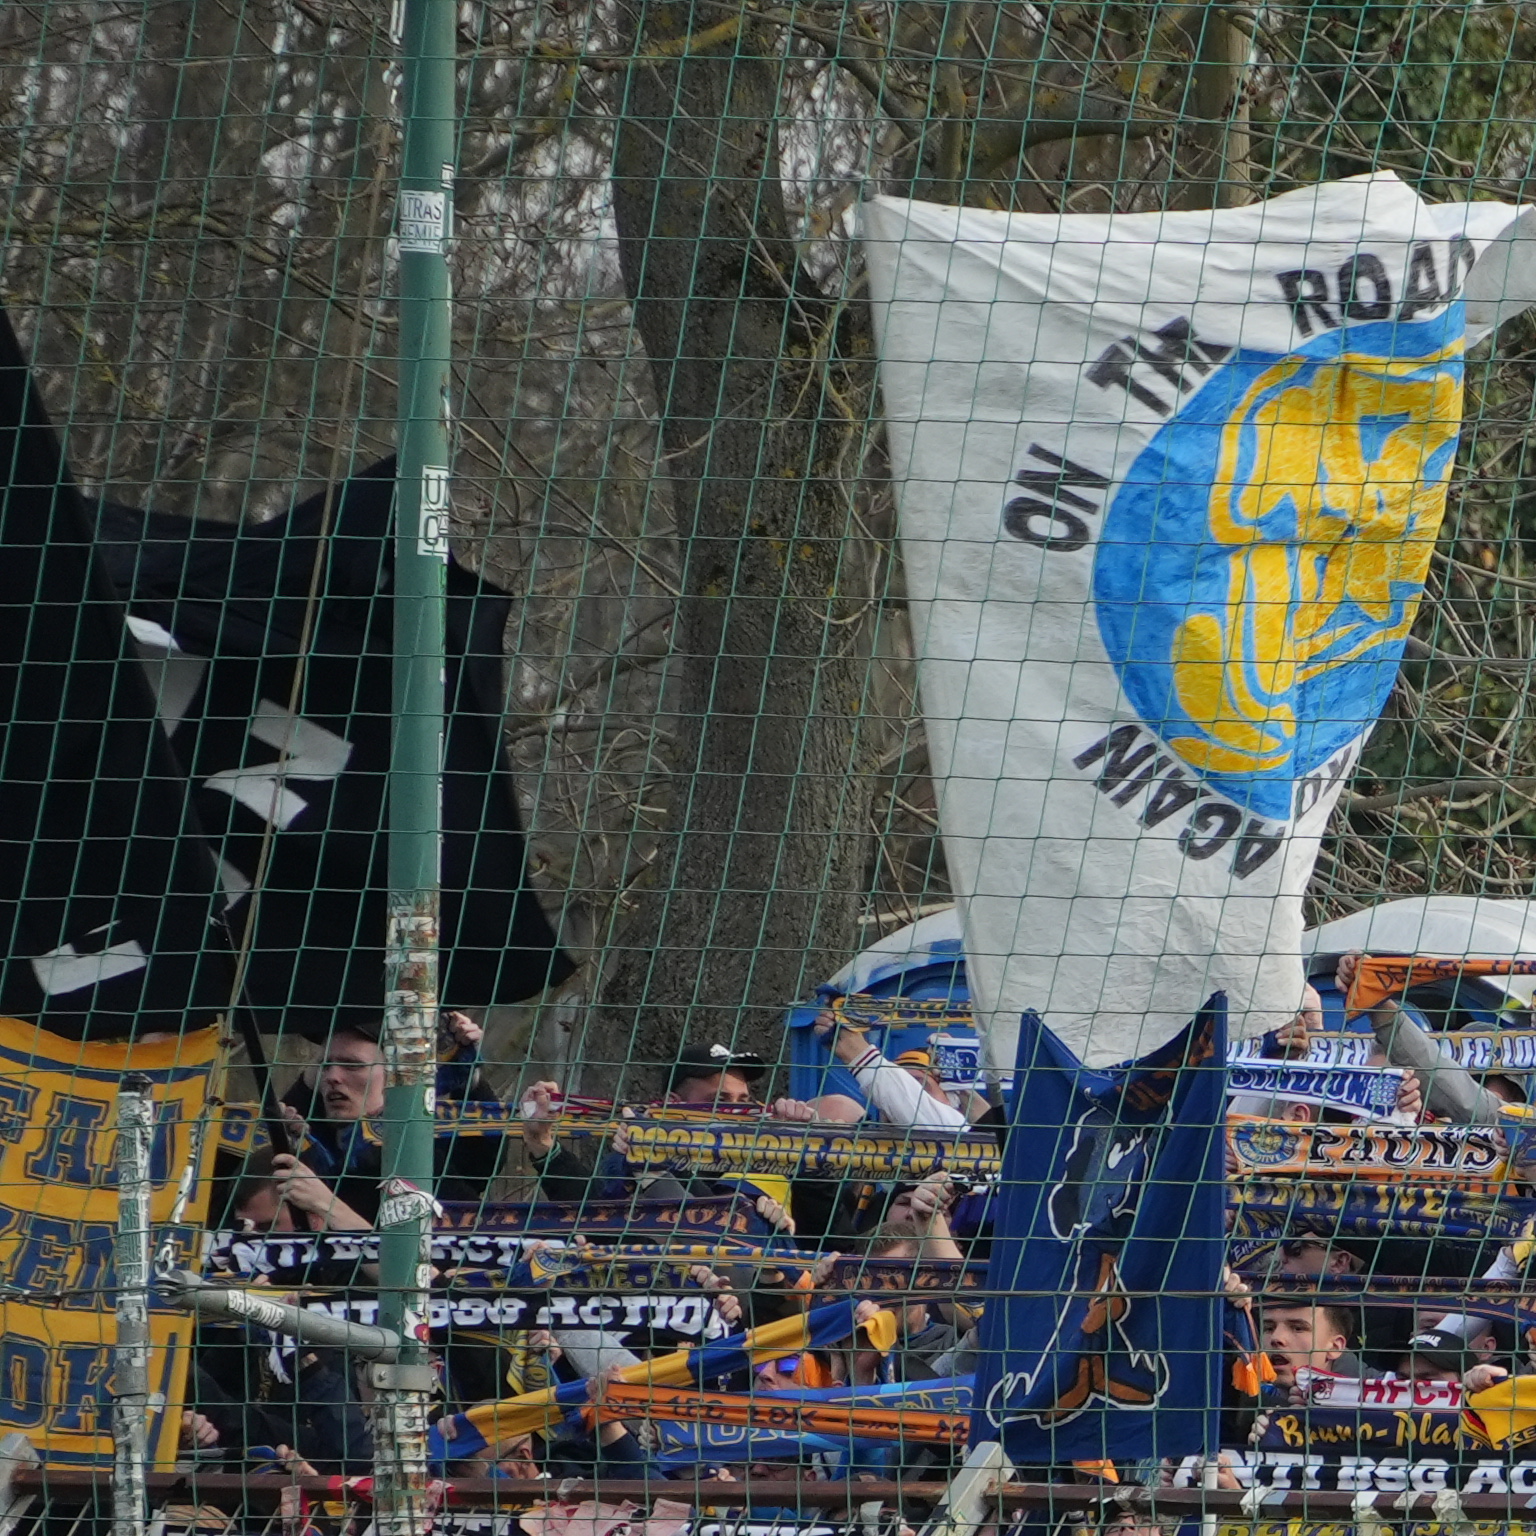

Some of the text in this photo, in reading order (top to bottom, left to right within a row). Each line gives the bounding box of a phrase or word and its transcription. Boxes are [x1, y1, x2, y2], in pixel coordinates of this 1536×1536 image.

[1003, 443, 1110, 553] ON
[1072, 724, 1284, 881] AGAIN
[1339, 1456, 1451, 1492] BSG
